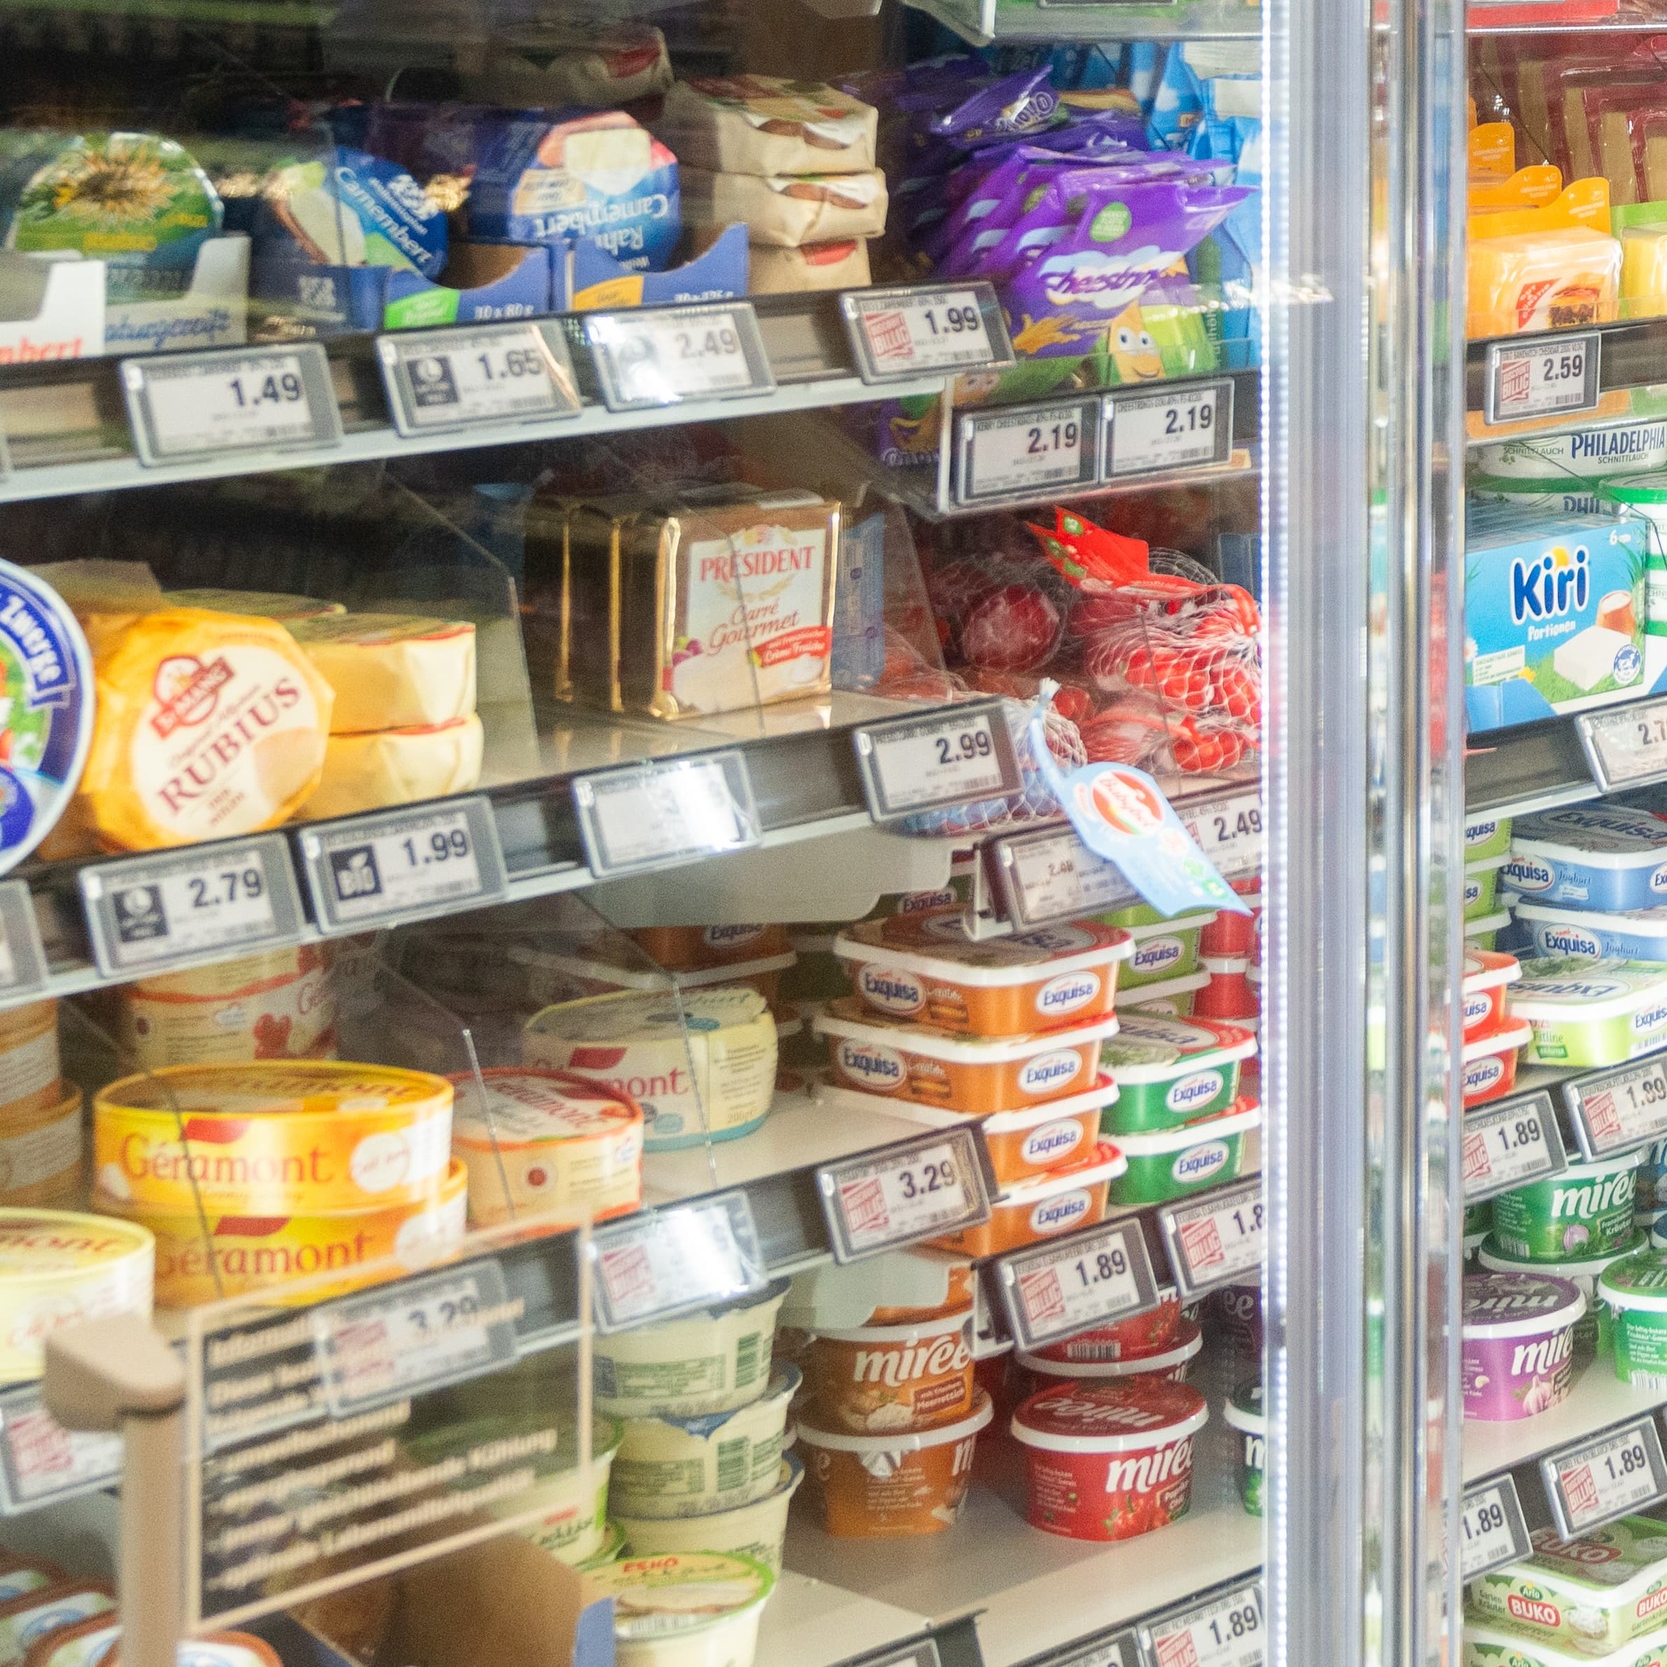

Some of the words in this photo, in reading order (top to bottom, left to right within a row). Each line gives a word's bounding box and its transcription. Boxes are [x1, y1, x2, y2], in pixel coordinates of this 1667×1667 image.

[332, 167, 433, 264] Camembert
[924, 307, 979, 335] 1.99
[477, 346, 542, 380] 1.65
[1543, 355, 1583, 381] 2.59
[229, 373, 302, 405] 1.49
[1166, 404, 1212, 434] 2.19
[1028, 423, 1078, 454] 2.19
[1571, 424, 1666, 459] PHILADELPHIA
[1597, 452, 1649, 465] SCHNITTLAUCH
[700, 545, 816, 582] PRÉSIDENT
[1512, 550, 1587, 621] Kiri
[732, 596, 780, 625] Carré
[1527, 620, 1576, 641] Portionen
[158, 677, 301, 814] RUBIUS
[936, 731, 992, 765] 2.99
[1214, 809, 1261, 842] 2.49
[402, 832, 471, 869] 1.99
[188, 868, 265, 909] 2.79
[1046, 977, 1095, 1007] Exquisa
[841, 1044, 901, 1076] Exquisa
[1173, 1073, 1224, 1107] Exquisa
[1626, 1079, 1667, 1106] 1.89
[121, 1132, 333, 1185] Géramont
[900, 1159, 956, 1197] 3.29
[1551, 1171, 1636, 1217] miree
[1076, 1250, 1127, 1286] 1.89
[853, 1339, 974, 1385] miree
[1605, 1445, 1646, 1480] 1.89
[1209, 1606, 1258, 1644] 1.89
[1512, 1600, 1556, 1624] BUKO
